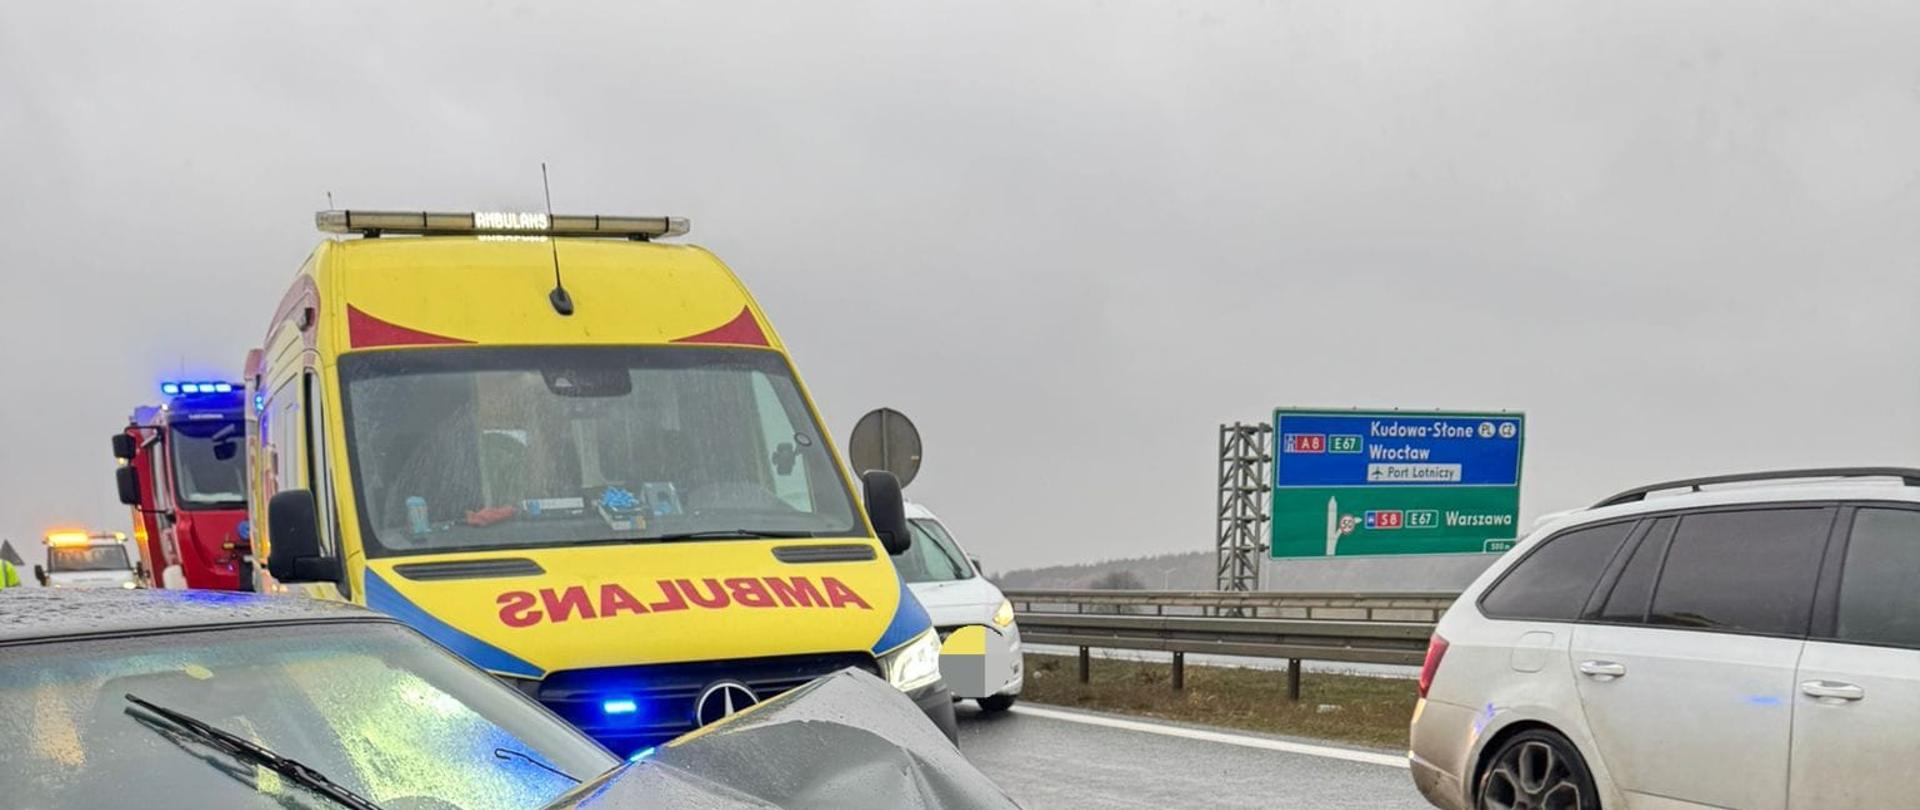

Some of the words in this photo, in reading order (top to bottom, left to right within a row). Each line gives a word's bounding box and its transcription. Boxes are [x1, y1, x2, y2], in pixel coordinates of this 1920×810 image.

[475, 211, 548, 230] AMBULANS
[1370, 420, 1474, 438] Kudowa-Słone
[1368, 443, 1431, 460] Wrocław
[1387, 466, 1409, 479] Port
[1412, 466, 1455, 480] Lotniczy
[1445, 510, 1512, 526] Warszawa
